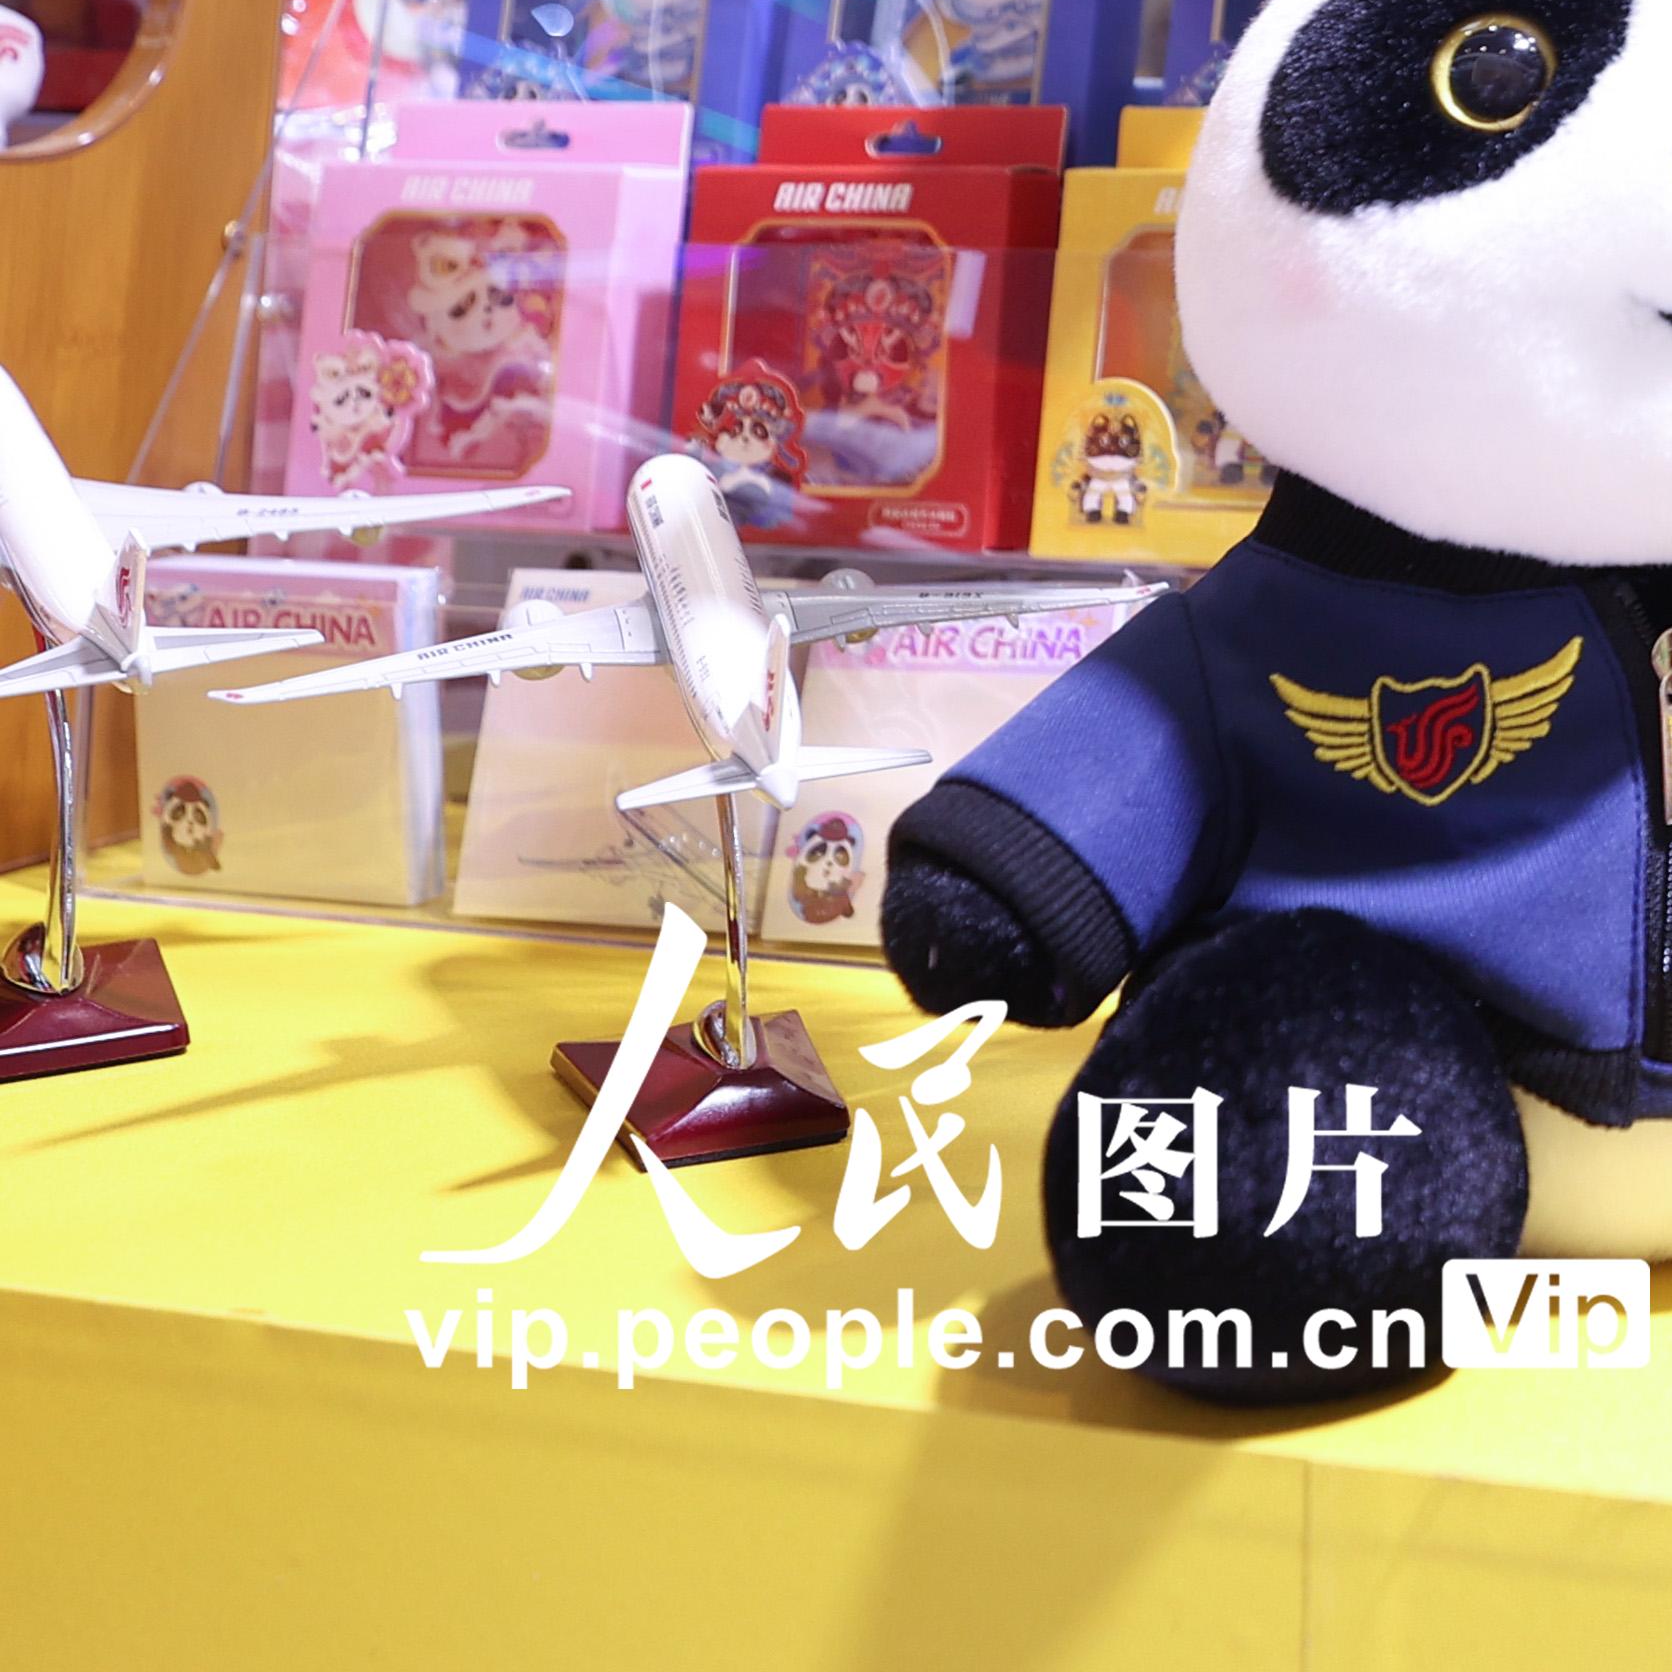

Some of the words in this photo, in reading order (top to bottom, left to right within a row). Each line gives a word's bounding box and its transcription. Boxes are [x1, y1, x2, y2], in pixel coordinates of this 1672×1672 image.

[773, 181, 825, 213] AIR
[824, 181, 914, 214] CHINA
[416, 647, 449, 661] AIR
[453, 632, 514, 653] CHINA
[893, 627, 958, 658] AIR
[969, 627, 1083, 660] CHINA
